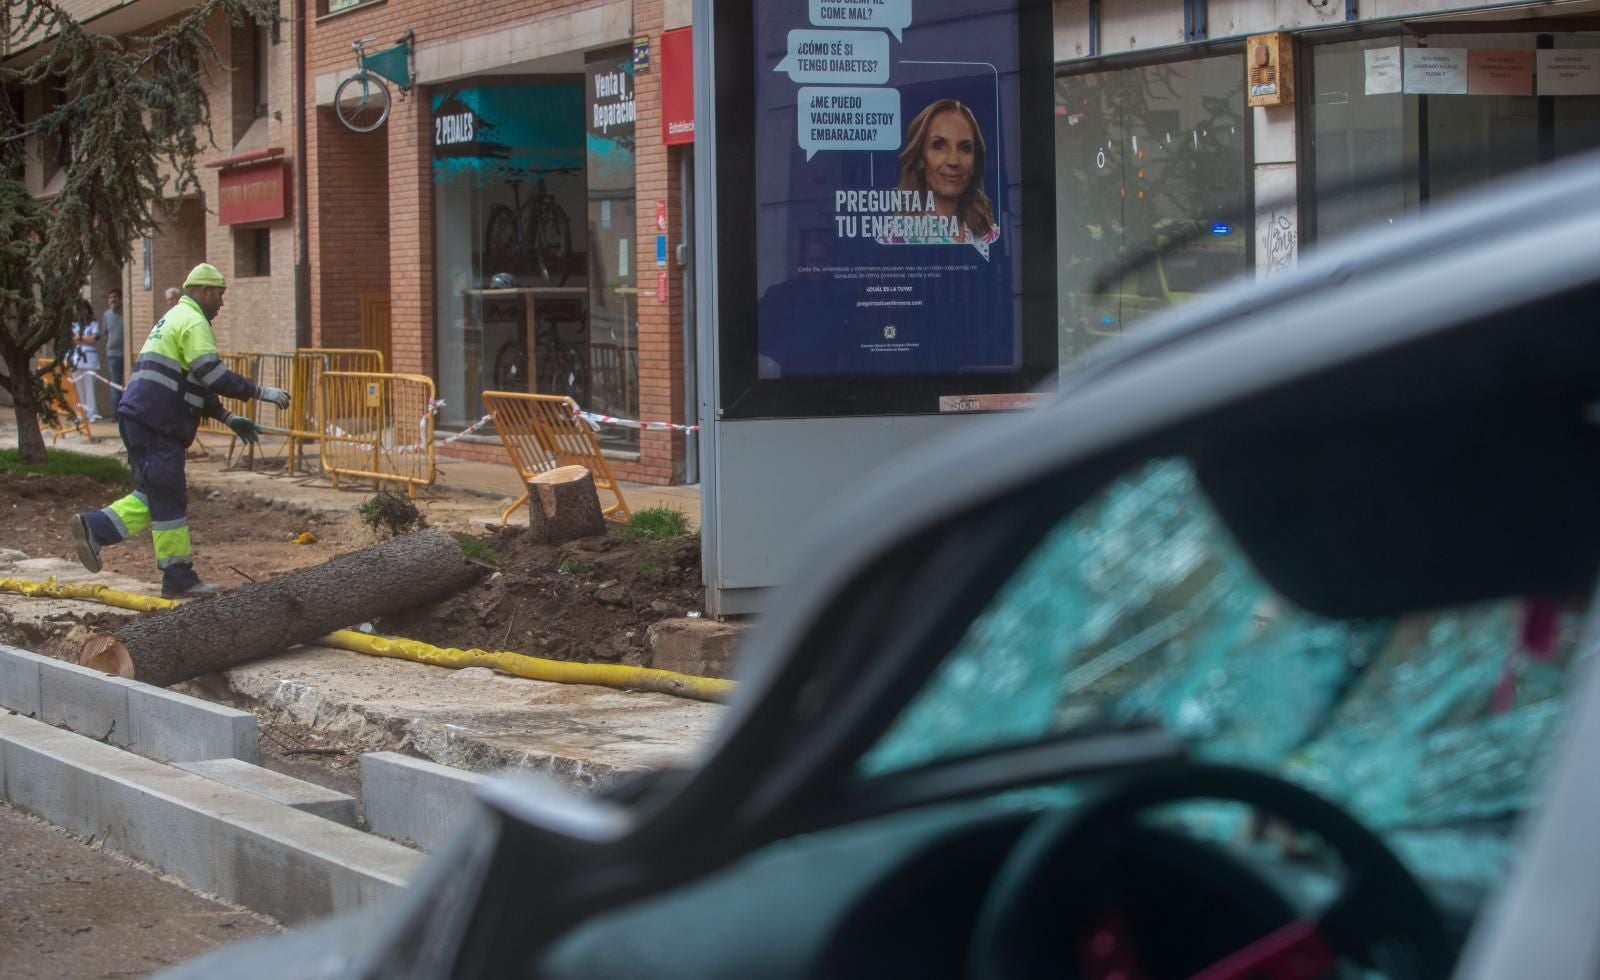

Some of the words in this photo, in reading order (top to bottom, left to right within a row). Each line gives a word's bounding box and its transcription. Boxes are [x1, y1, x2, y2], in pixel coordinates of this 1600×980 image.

[821, 6, 846, 20] COME
[848, 7, 873, 20] MAL?
[798, 40, 829, 56] ¿CÓMO
[831, 41, 842, 56] SÉ
[844, 44, 853, 56] SI
[798, 59, 828, 72] TENGO
[830, 60, 878, 73] DIABETES?
[595, 72, 618, 98] Venta
[620, 72, 625, 101] y
[811, 96, 829, 109] ¿ME
[832, 97, 862, 109] PUEDO
[811, 112, 853, 125] VACUNAR
[855, 112, 864, 125] SI
[866, 112, 895, 126] ESTOY
[435, 117, 441, 145] 2
[442, 112, 473, 144] PEDALES
[811, 128, 878, 141] EMBARAZADA?
[835, 190, 922, 212] PREGUNTA
[925, 191, 936, 212] A
[835, 215, 857, 238] TU
[861, 215, 960, 238] ENFERMERA
